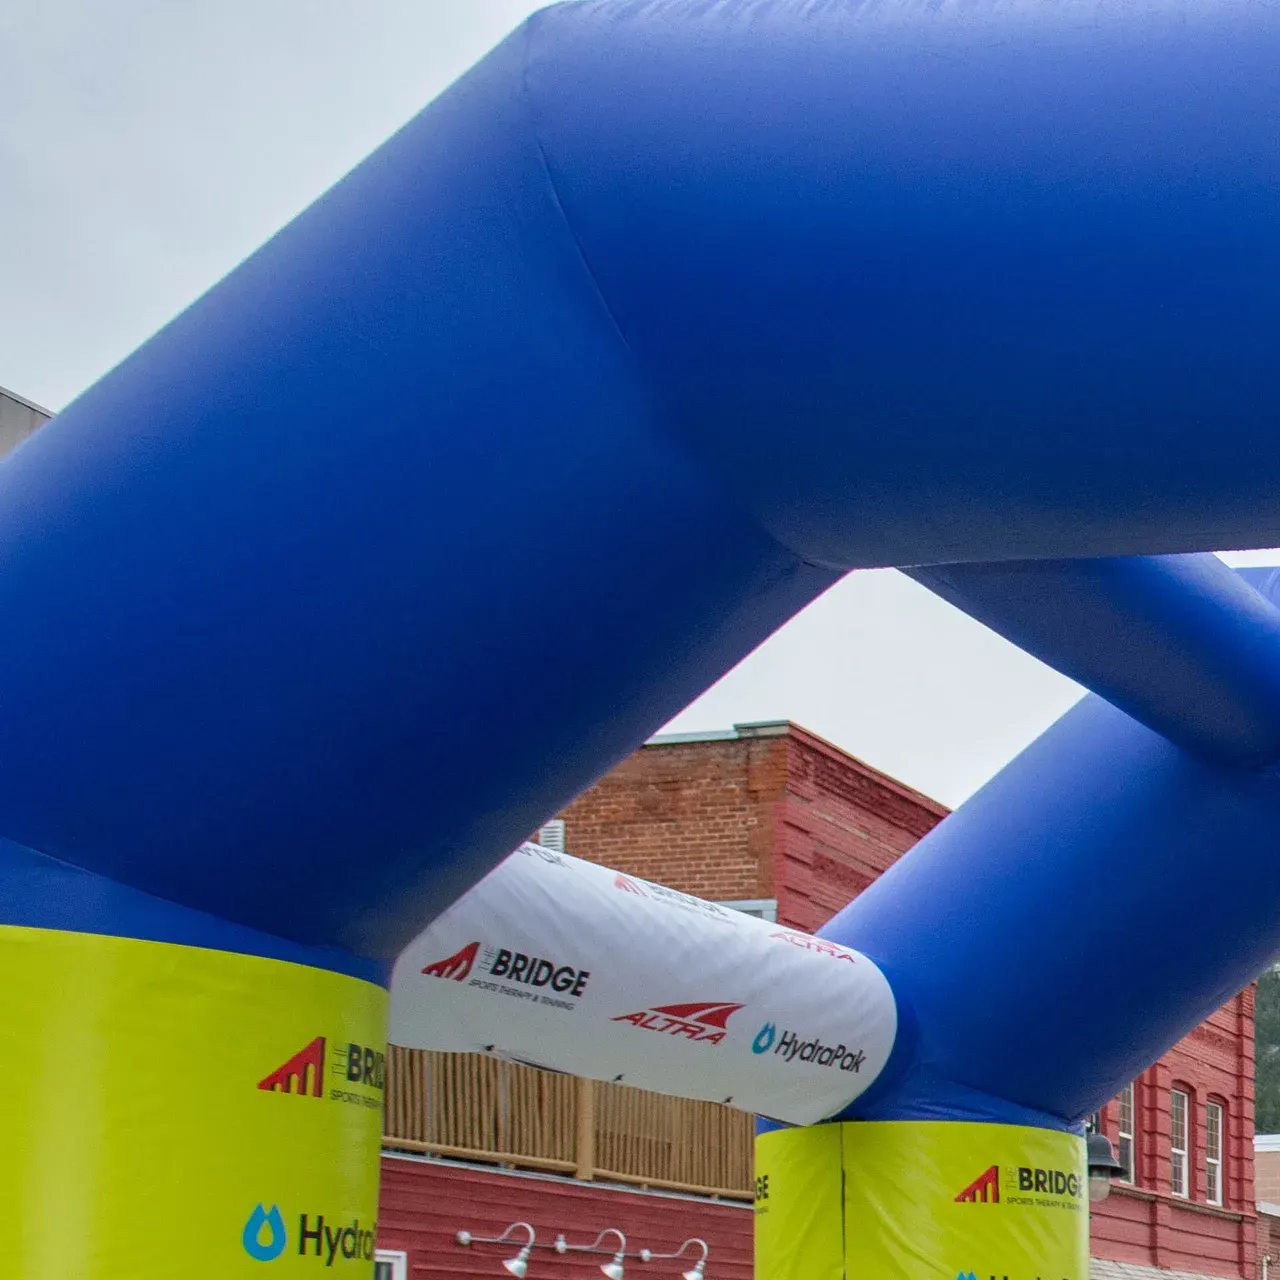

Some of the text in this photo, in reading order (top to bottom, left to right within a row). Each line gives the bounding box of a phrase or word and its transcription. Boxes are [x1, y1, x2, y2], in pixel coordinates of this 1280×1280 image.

[490, 949, 590, 997] BRIDGE
[608, 1011, 728, 1046] ALTRA
[774, 1030, 867, 1074] HydraPak
